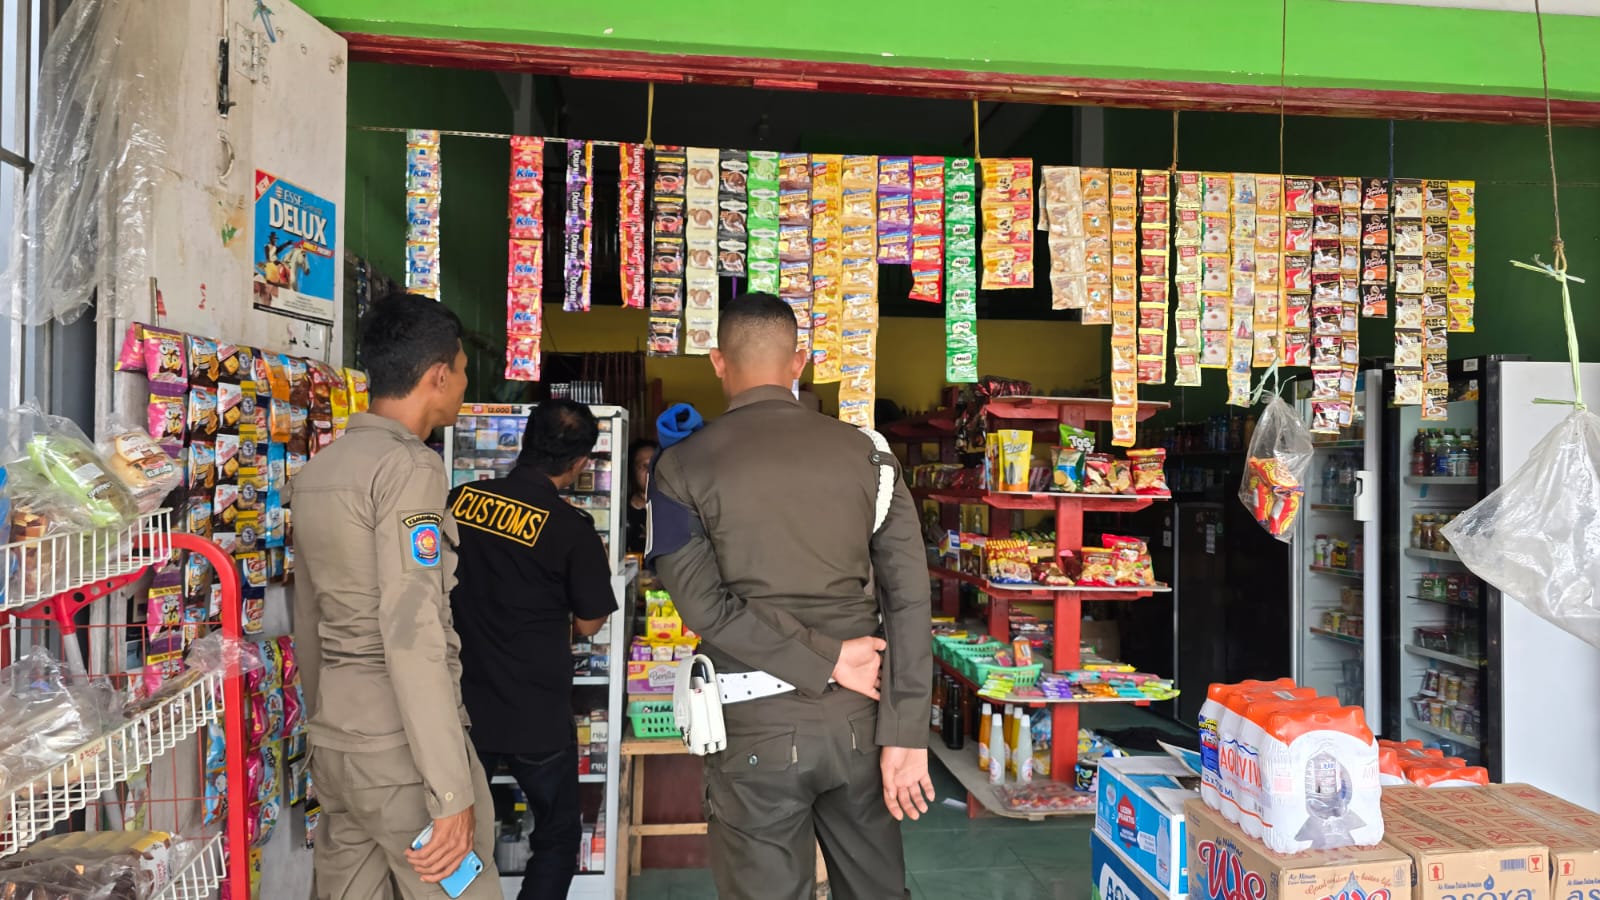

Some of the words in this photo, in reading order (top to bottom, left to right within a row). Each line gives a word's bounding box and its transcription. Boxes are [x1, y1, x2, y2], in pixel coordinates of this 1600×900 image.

[516, 168, 538, 178] Klin
[1425, 181, 1447, 189] ABC
[269, 196, 327, 246] DELUX
[516, 216, 538, 226] Klin
[1425, 216, 1447, 224] ABC
[1425, 319, 1447, 327] ABC
[1426, 353, 1447, 361] ABC
[453, 492, 542, 540] CUSTOMS
